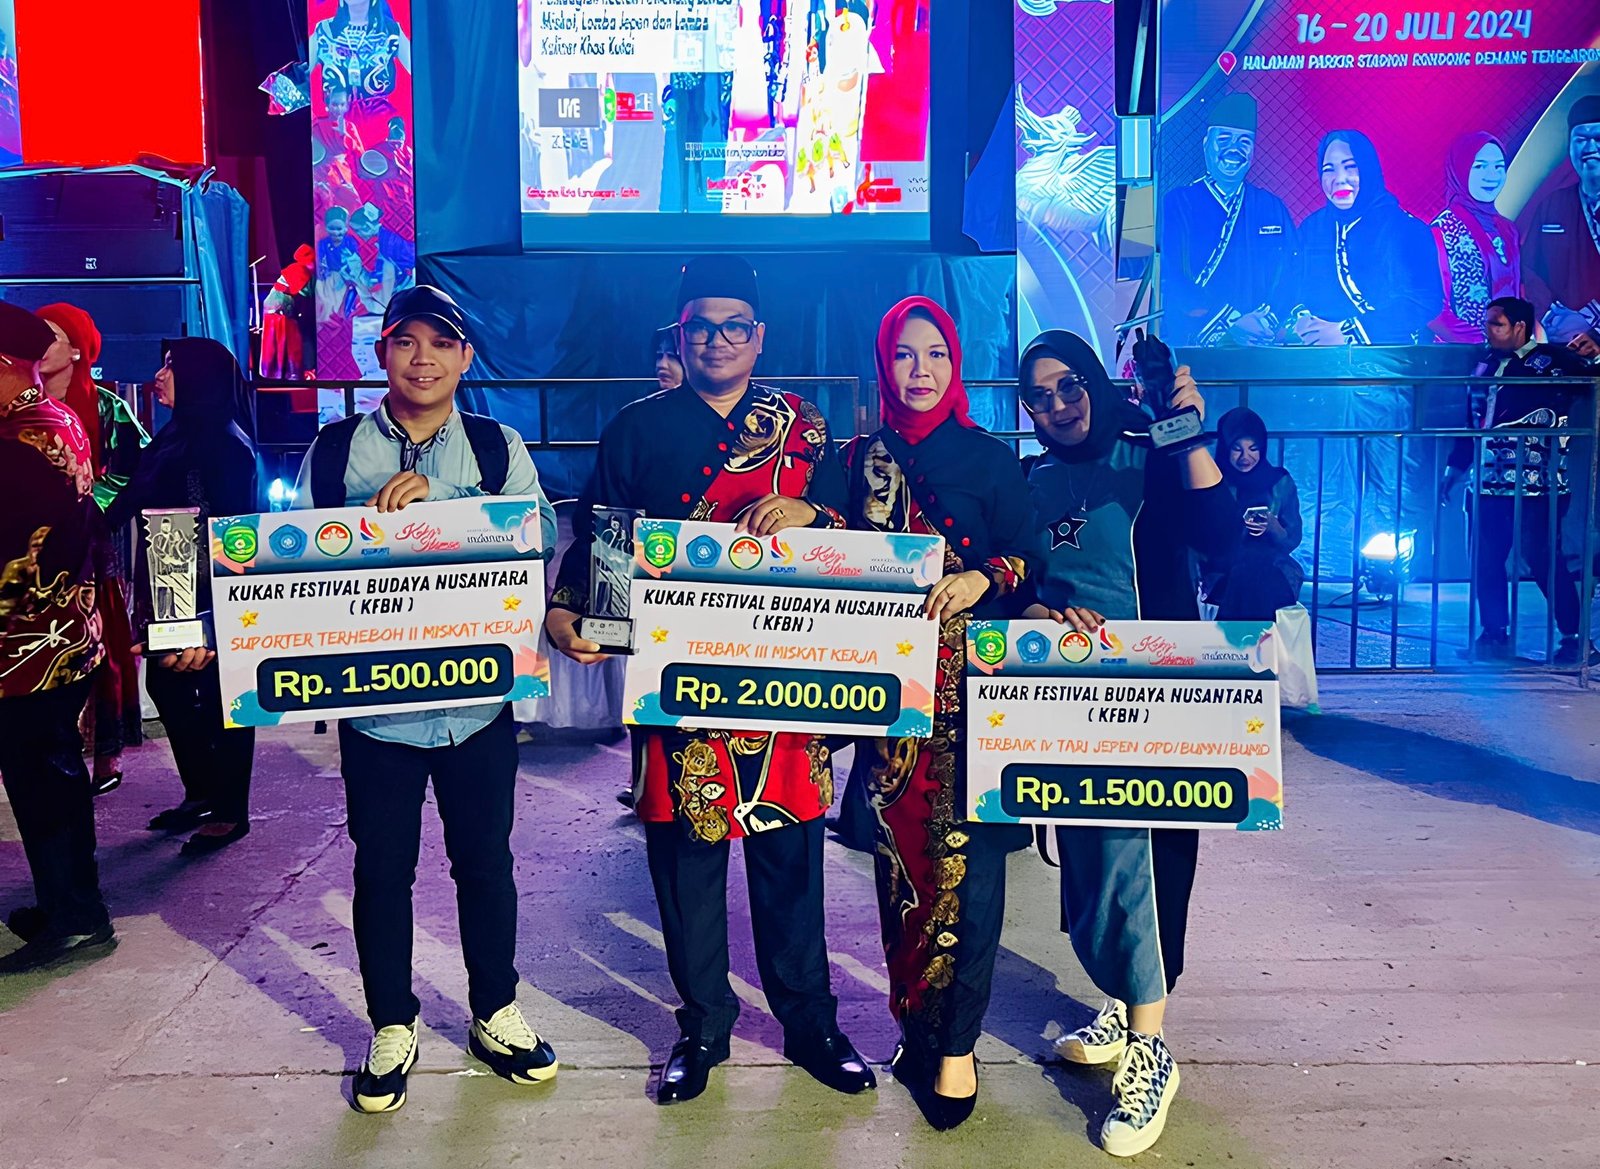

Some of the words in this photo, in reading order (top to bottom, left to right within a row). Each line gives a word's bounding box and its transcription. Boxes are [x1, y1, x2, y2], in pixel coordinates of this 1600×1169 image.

[1296, 13, 1326, 43] 16
[1353, 12, 1388, 42] 20
[1396, 12, 1454, 41] JULI
[1464, 9, 1532, 40] 2024
[1242, 54, 1305, 70] HALAMAN
[1308, 54, 1354, 69] PARKIR
[1357, 53, 1409, 68] STADION
[228, 584, 284, 602] KUKAR
[290, 580, 361, 598] FESTIVAL
[367, 576, 430, 593] BUDAYA
[435, 570, 529, 590] NUSANTARA
[643, 589, 696, 607] KUKAR
[700, 592, 766, 610] FESTIVAL
[771, 596, 830, 614] BUDAYA
[835, 599, 924, 619] NUSANTARA
[231, 633, 314, 651] SUPORTER
[317, 628, 403, 646] TERHEBOH
[423, 621, 478, 640] MISKAT
[484, 619, 534, 635] KERJA
[687, 640, 750, 656] TERBAIK
[772, 645, 828, 662] MISKAT
[831, 648, 878, 665] KERJA
[273, 671, 332, 703] Rp.
[342, 657, 499, 693] 1.500.000
[675, 675, 728, 710] Rp.
[737, 679, 887, 712] 2.000.000
[978, 684, 1029, 701] KUKAR
[1033, 686, 1099, 702] FESTIVAL
[1104, 686, 1165, 703] BUDAYA
[1171, 688, 1263, 705] NUSANTARA
[977, 737, 1036, 751] TERBAIK
[1057, 739, 1088, 753] TARI
[1093, 740, 1138, 754] JEPEN
[1016, 777, 1069, 811] Rp.
[1079, 777, 1233, 809] 1.500.000
